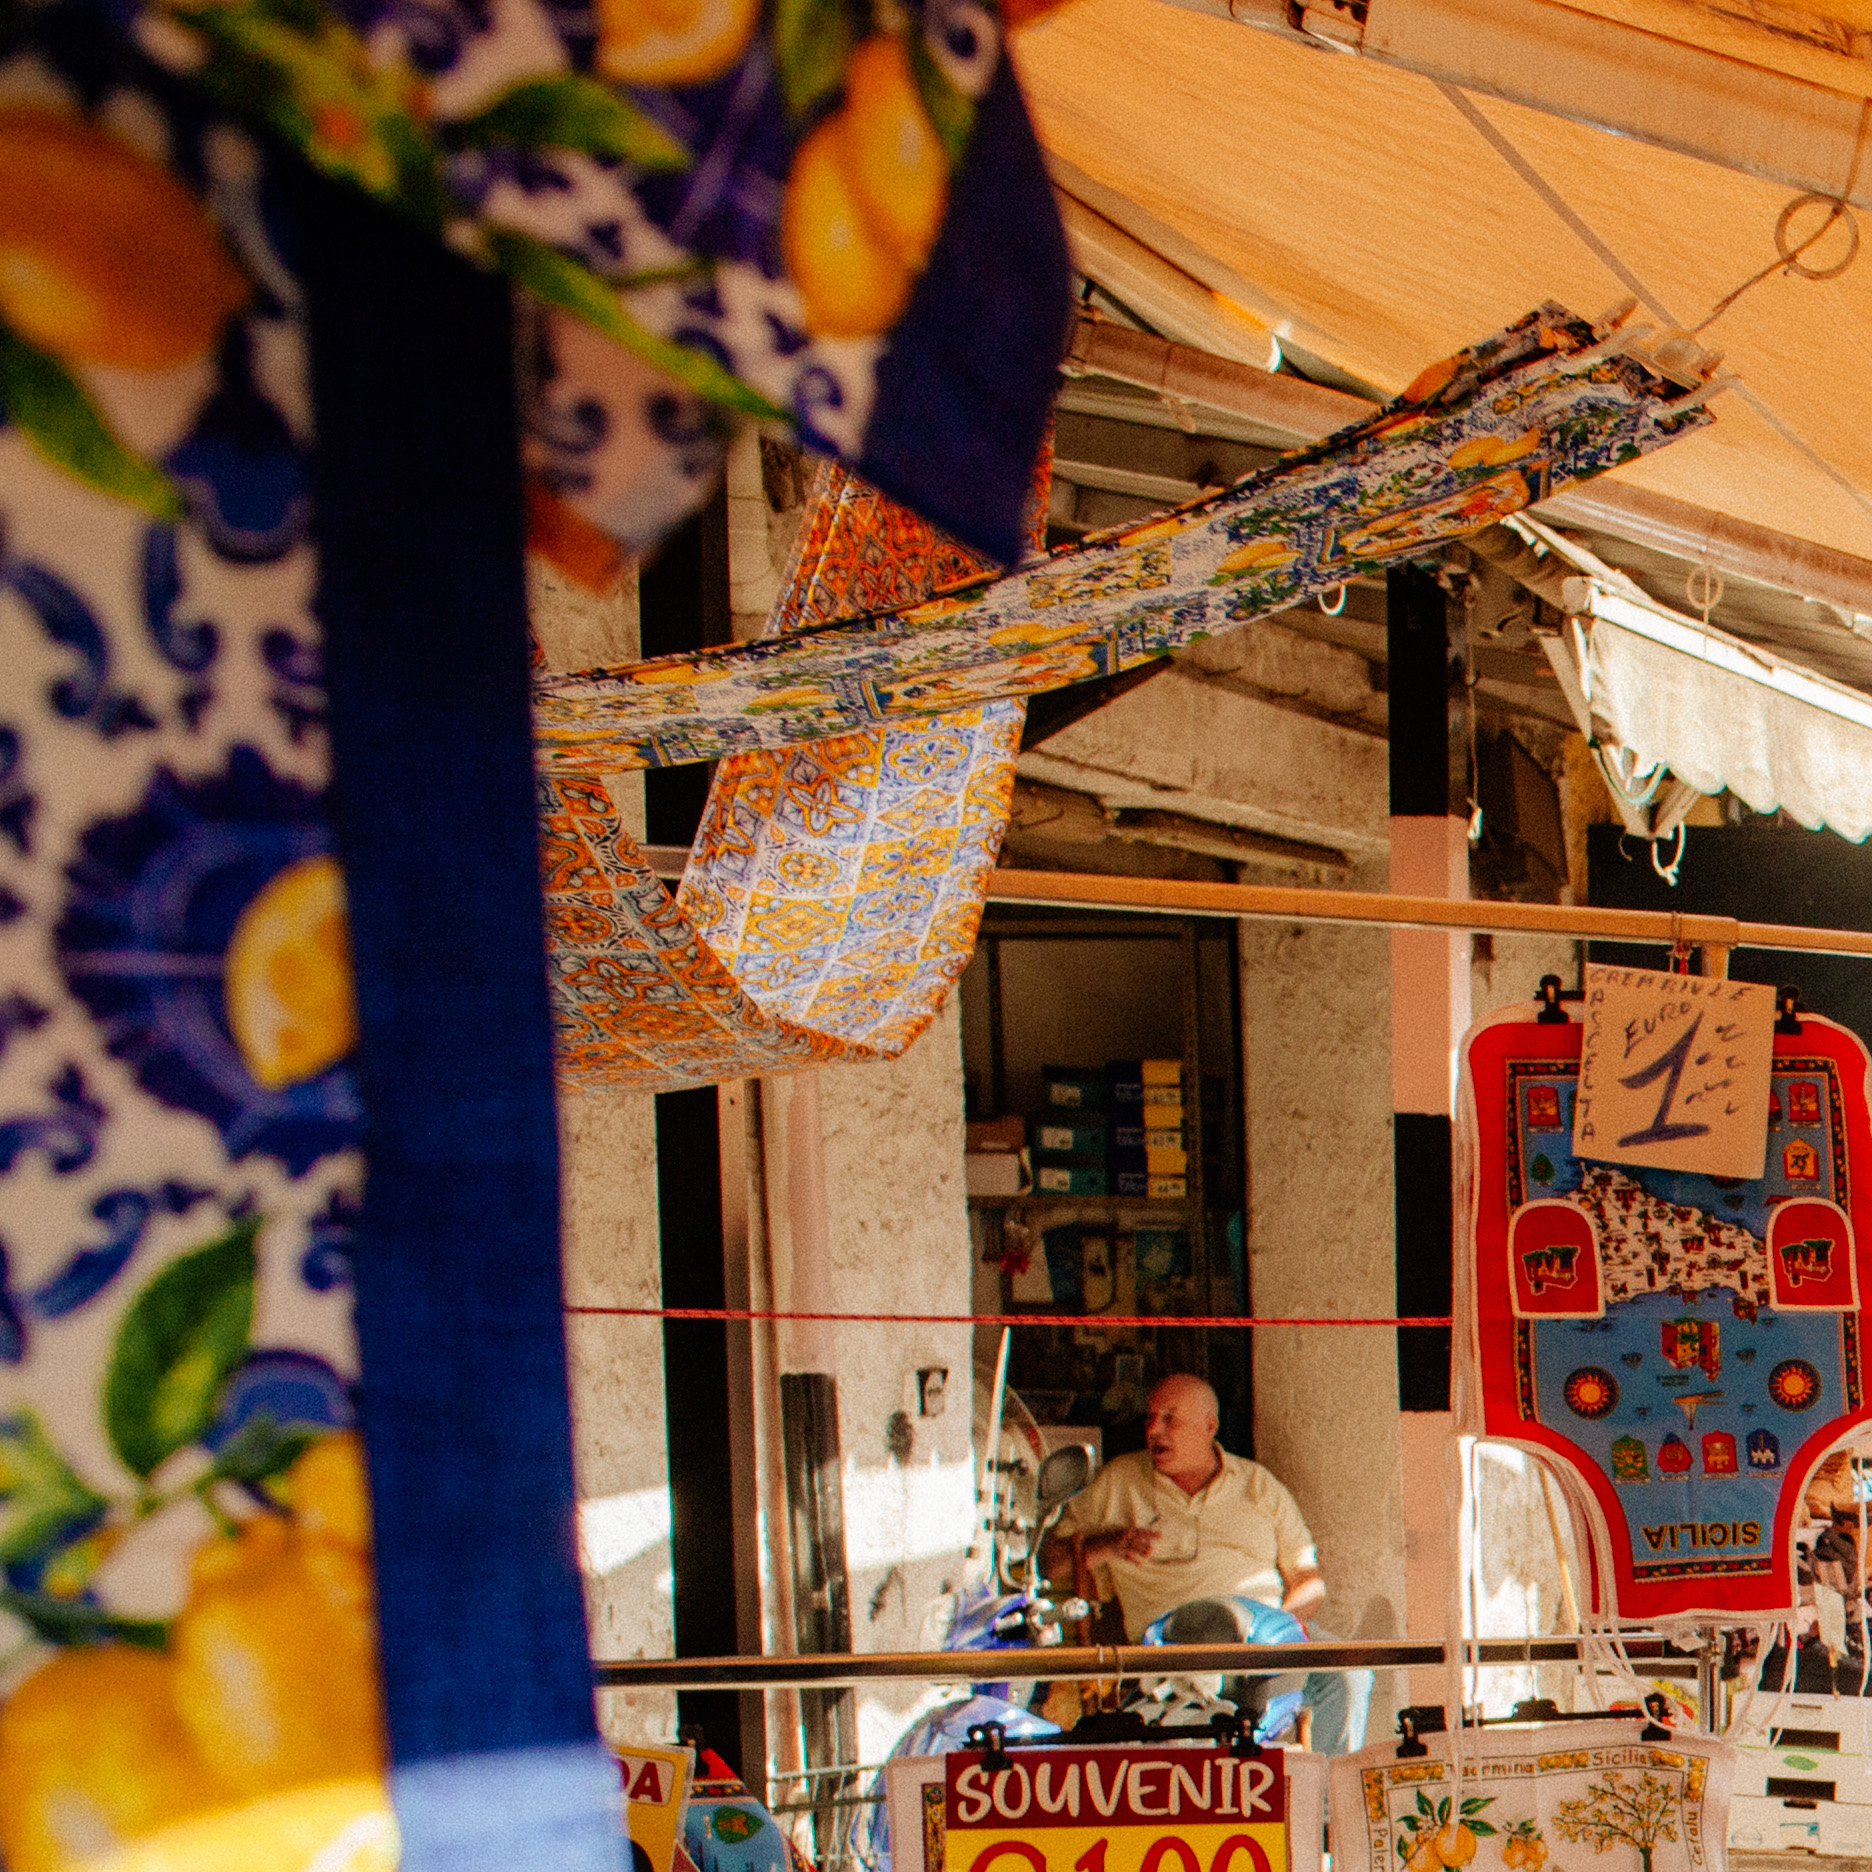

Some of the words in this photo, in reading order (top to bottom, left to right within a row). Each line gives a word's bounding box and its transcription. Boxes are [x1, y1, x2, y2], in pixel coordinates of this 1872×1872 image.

[1623, 1001, 1692, 1059] EURO
[1617, 1009, 1712, 1148] 1
[1641, 1520, 1762, 1550] SICILIA
[1592, 1749, 1648, 1767] Sicilia
[955, 1757, 1276, 1823] SOUVENIR
